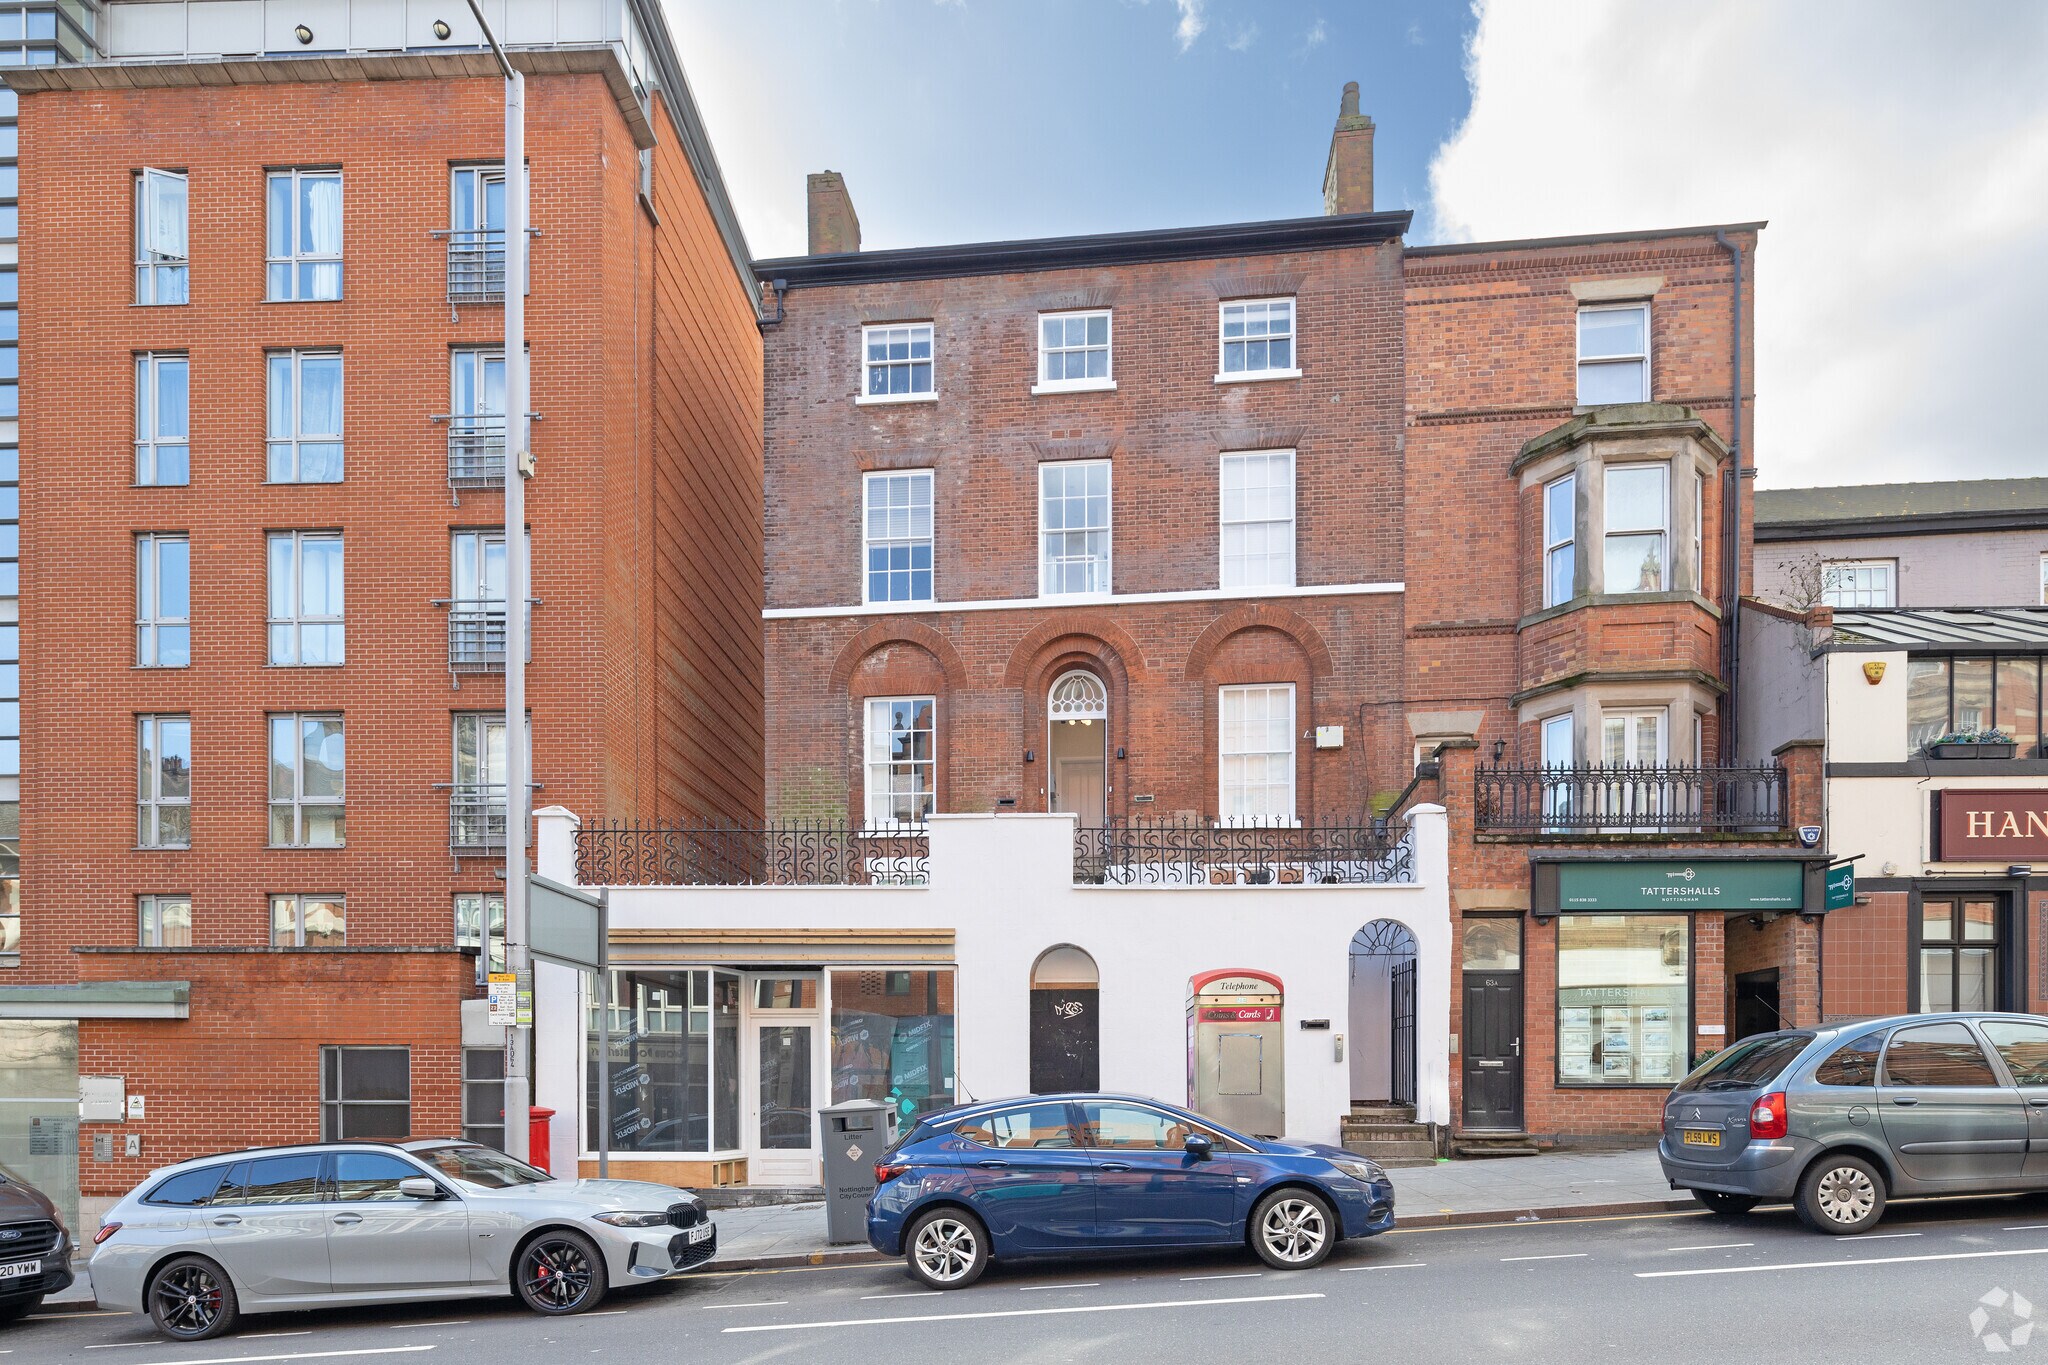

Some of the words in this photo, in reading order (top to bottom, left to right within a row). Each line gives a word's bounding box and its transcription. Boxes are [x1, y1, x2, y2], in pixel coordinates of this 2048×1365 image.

[1640, 886, 1721, 896] TATTERSHALLS
[1220, 982, 1258, 991] Telephone
[1485, 979, 1498, 987] 63A
[1238, 1009, 1261, 1019] Cards
[908, 1020, 932, 1037] MIDFIX
[904, 1063, 928, 1080] MIDFIX
[614, 1079, 639, 1096] MIDFIX
[615, 1122, 640, 1140] MIDFIX
[844, 1133, 863, 1141] Litter
[1686, 1131, 1702, 1143] FL59
[1703, 1133, 1717, 1144] LWS
[129, 1140, 137, 1149] A
[17, 1262, 37, 1275] YWW
